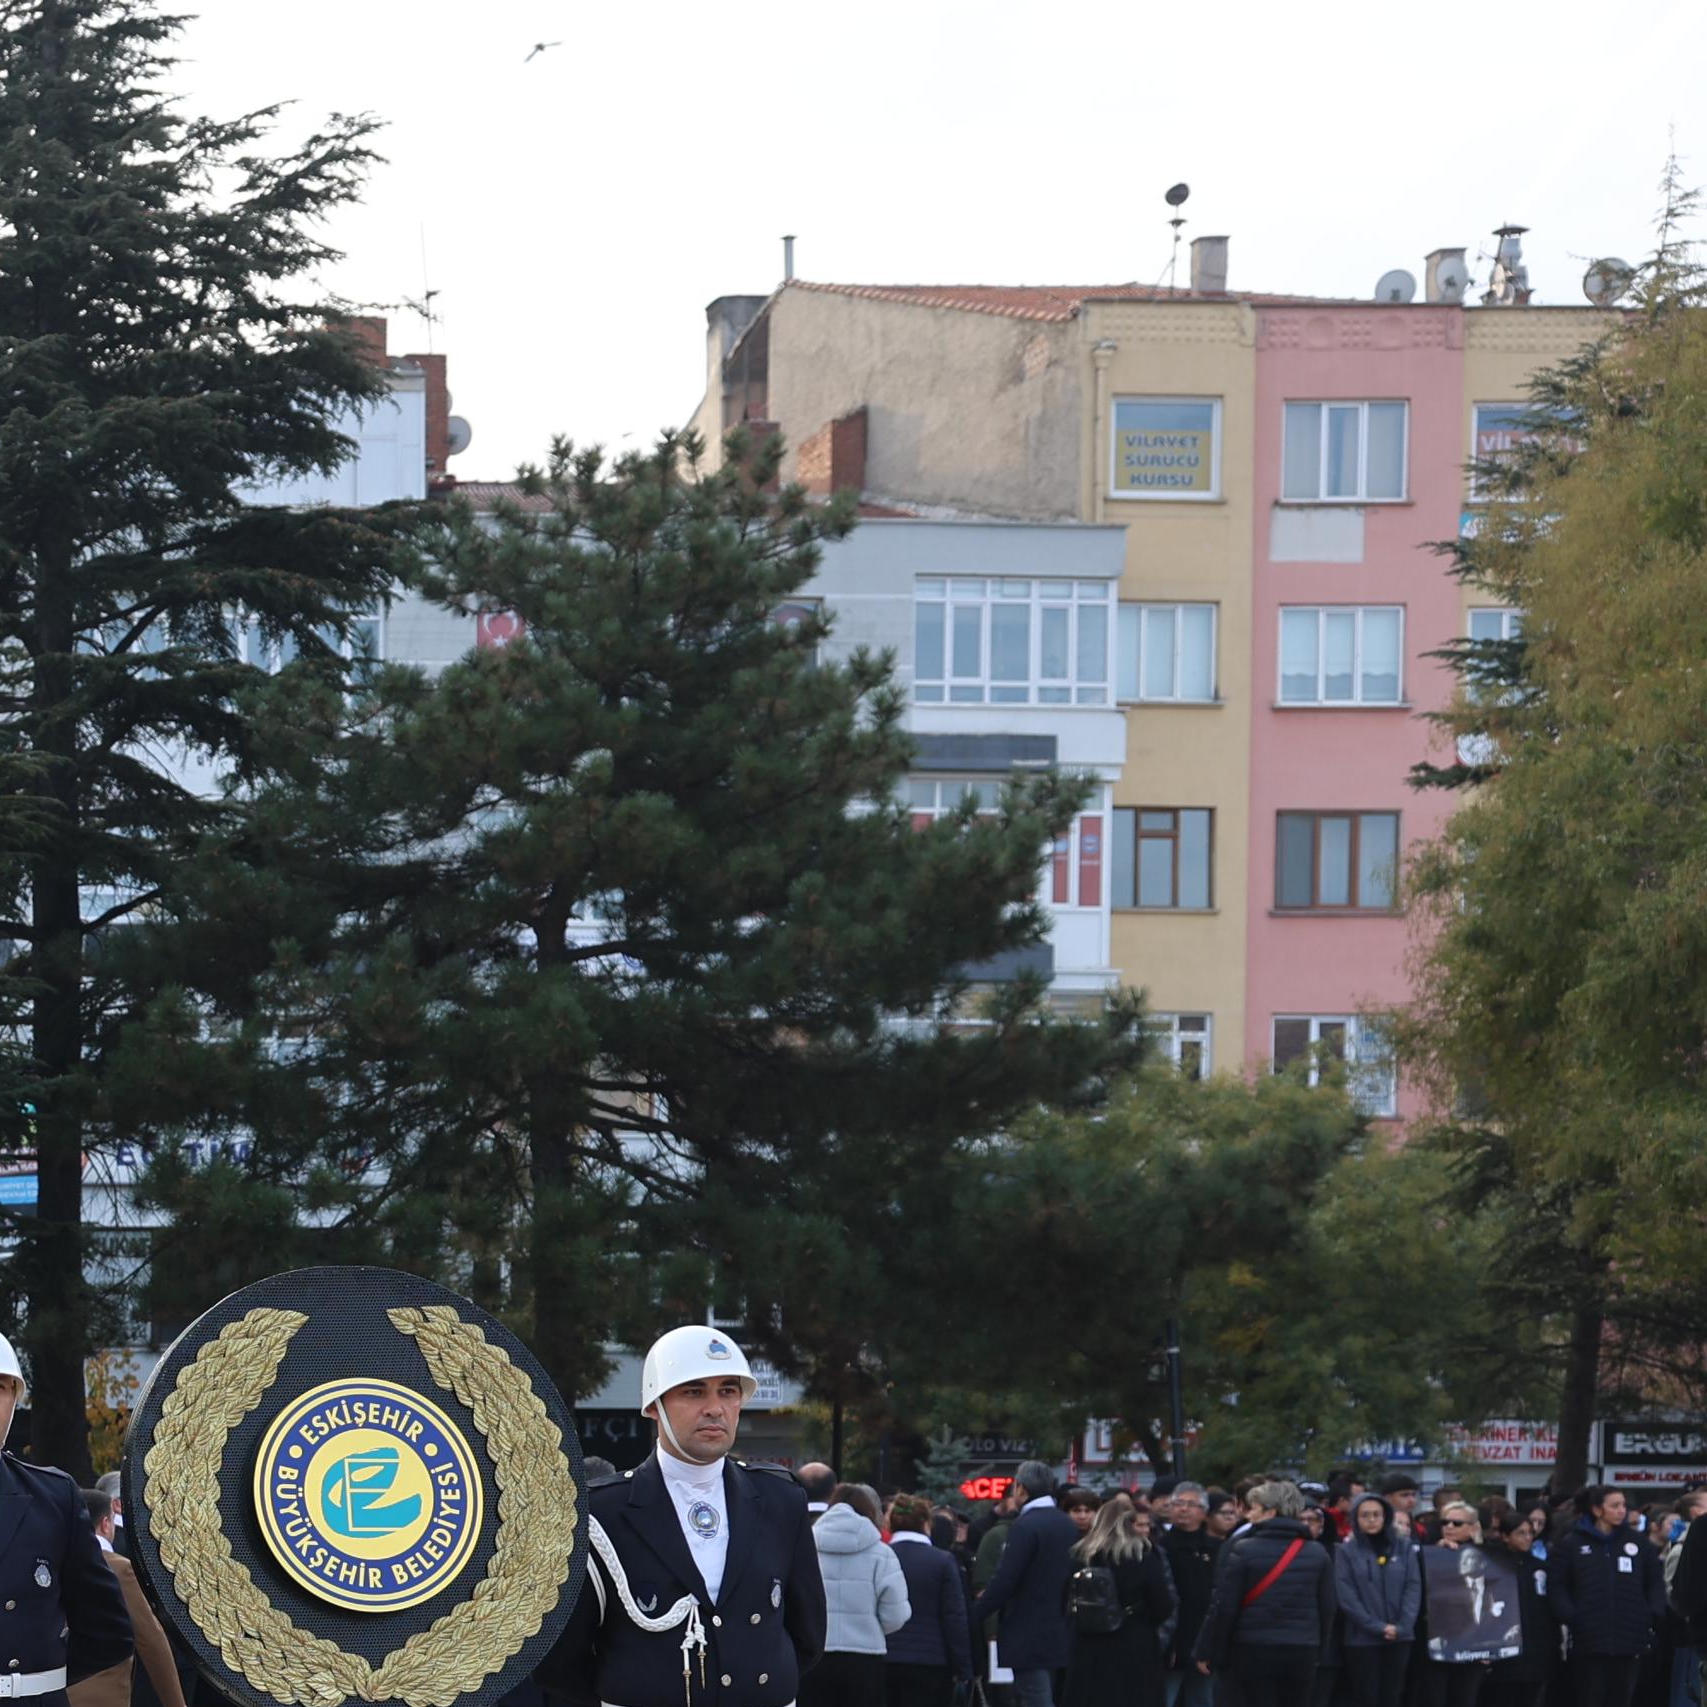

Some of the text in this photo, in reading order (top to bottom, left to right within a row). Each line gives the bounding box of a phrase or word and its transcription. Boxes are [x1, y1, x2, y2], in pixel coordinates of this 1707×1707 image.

[1130, 473, 1193, 486] KURSU
[299, 1399, 423, 1444] ESKİŞEHİR
[278, 1463, 461, 1588] BÜYÜKŞEHİR BELEDİYESİ
